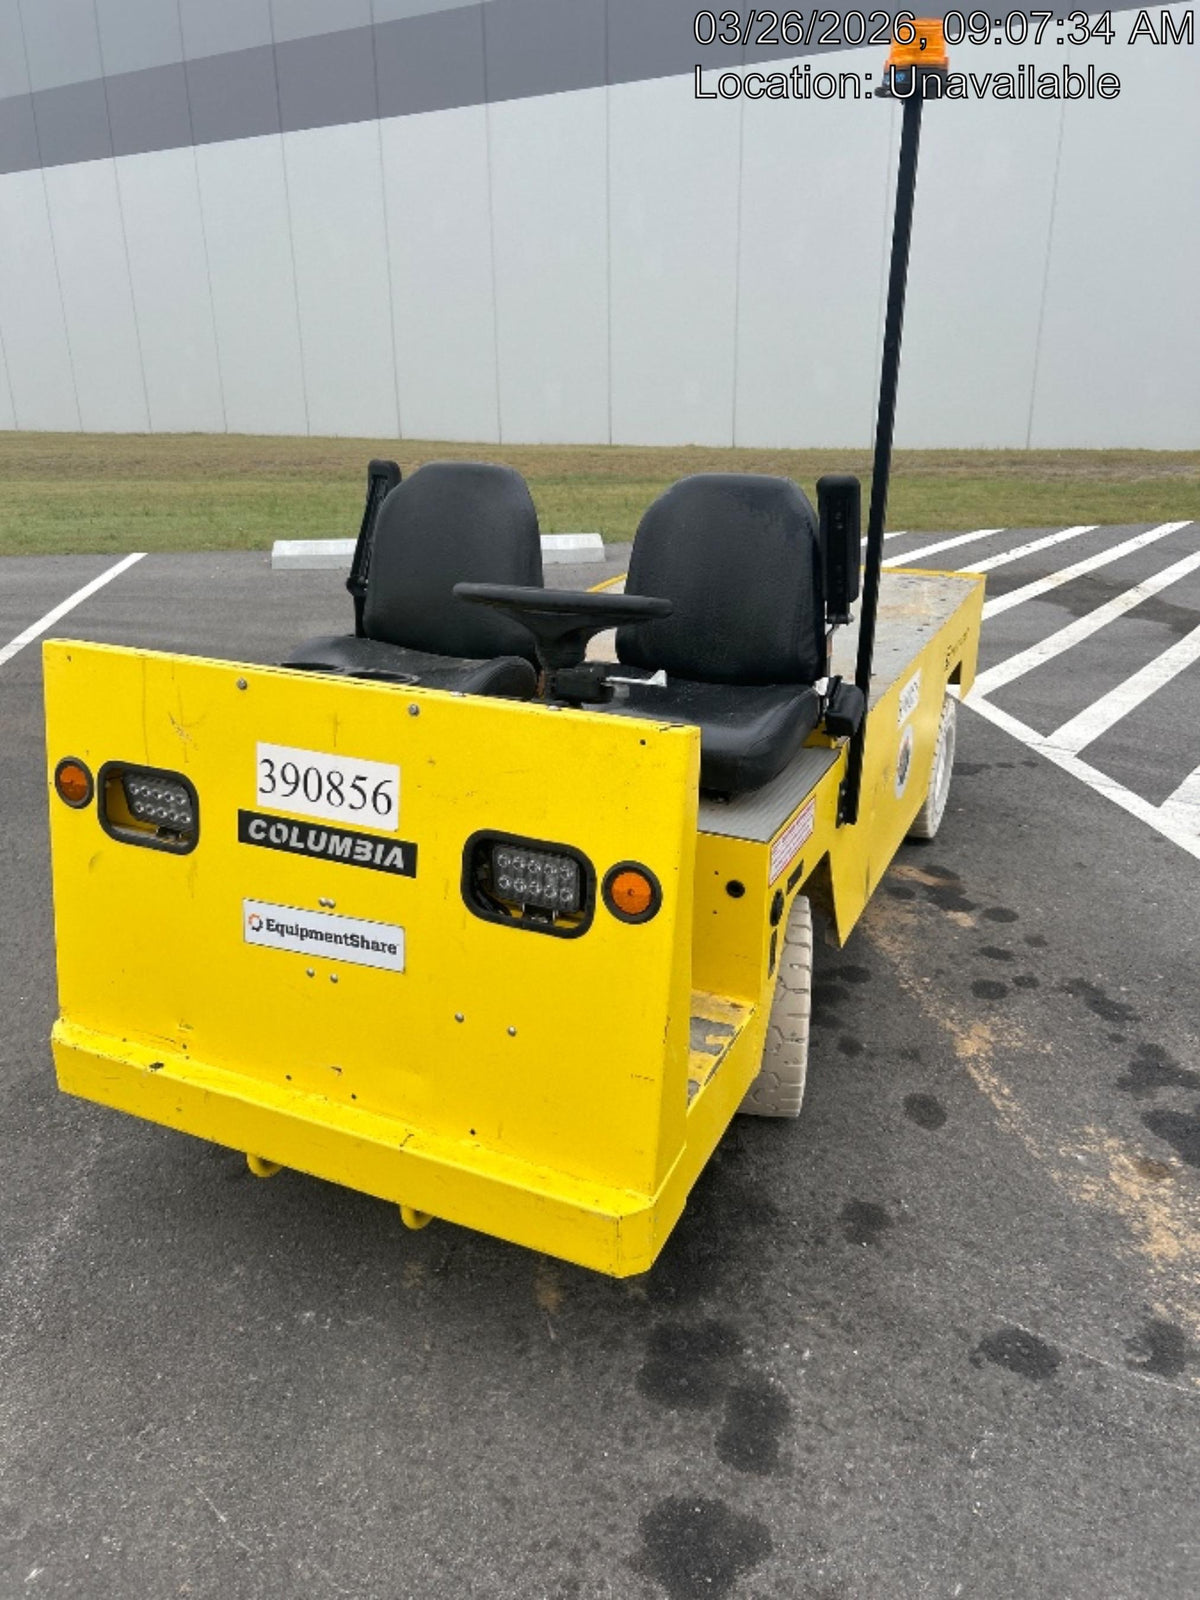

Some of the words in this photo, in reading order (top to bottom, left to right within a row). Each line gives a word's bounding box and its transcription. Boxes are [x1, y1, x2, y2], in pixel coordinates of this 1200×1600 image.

[258, 758, 393, 816] 390856
[248, 818, 405, 870] COLUMBIA
[265, 917, 398, 956] EquipmentShare
